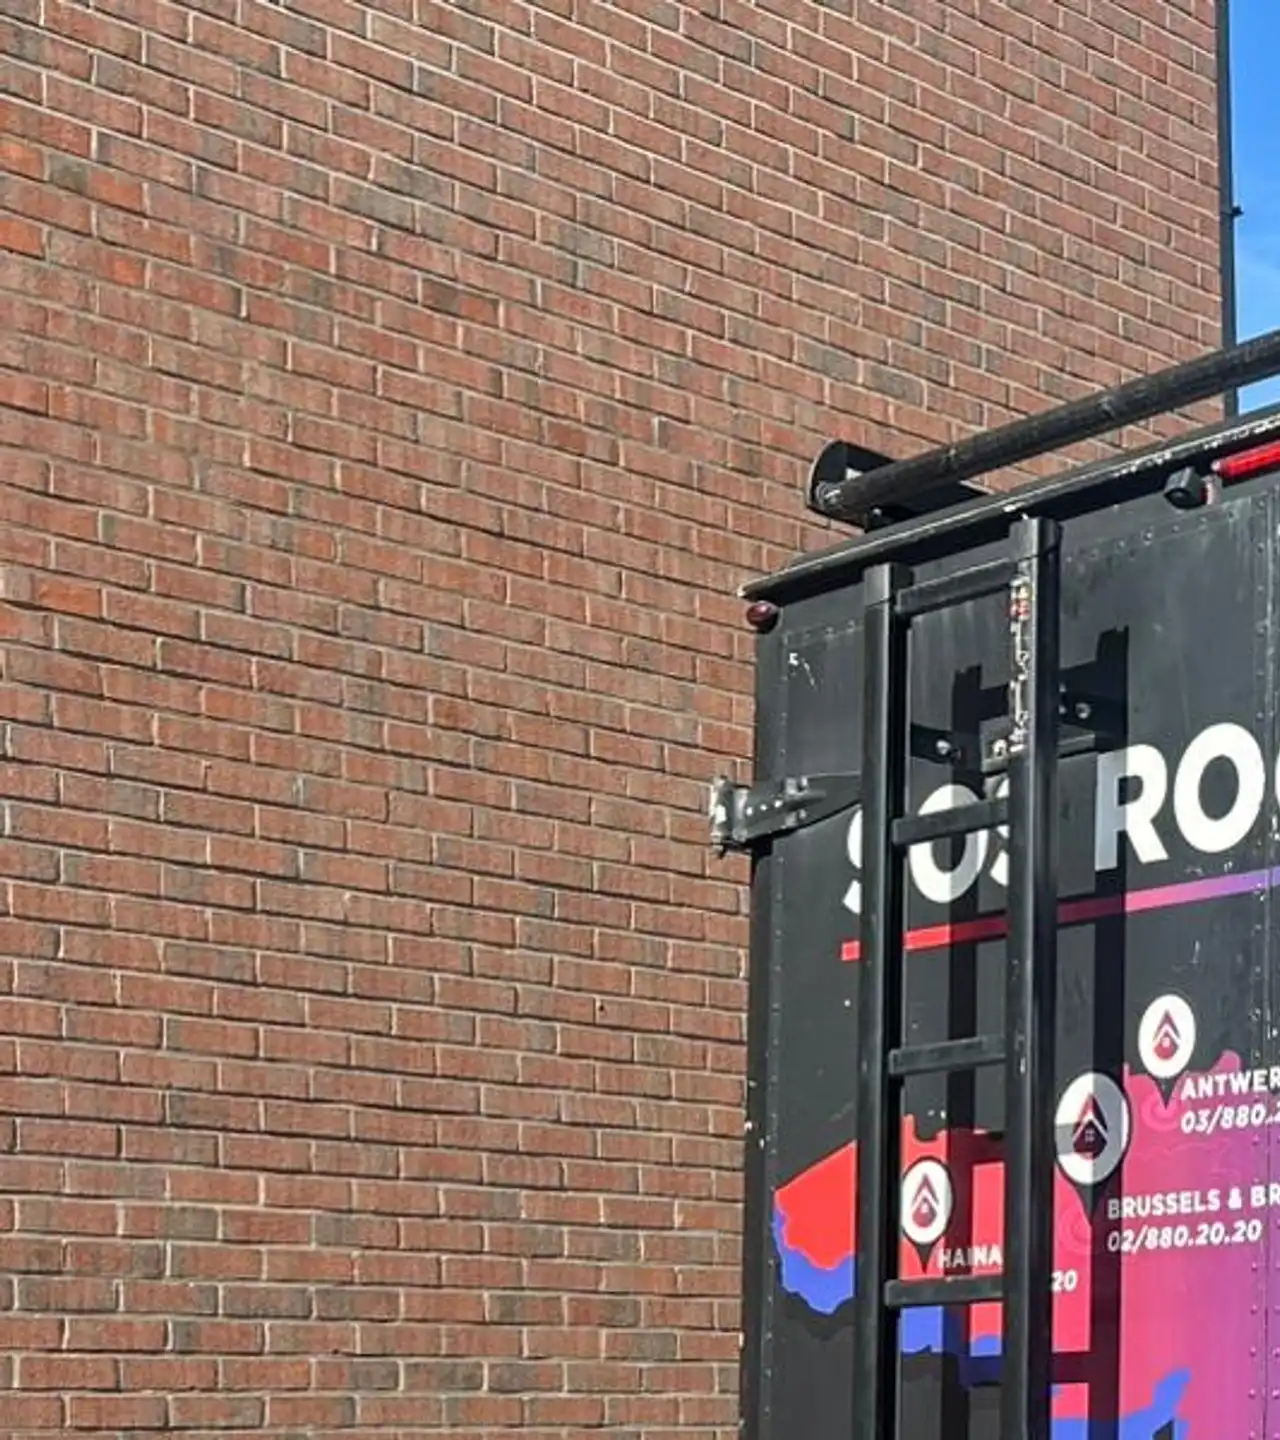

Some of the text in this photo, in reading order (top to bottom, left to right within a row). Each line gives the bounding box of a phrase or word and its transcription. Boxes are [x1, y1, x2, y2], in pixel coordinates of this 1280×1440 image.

[1107, 1189, 1221, 1220] BRUSSELS
[1228, 1187, 1243, 1209] &
[1107, 1219, 1262, 1254] 02/880.20.20
